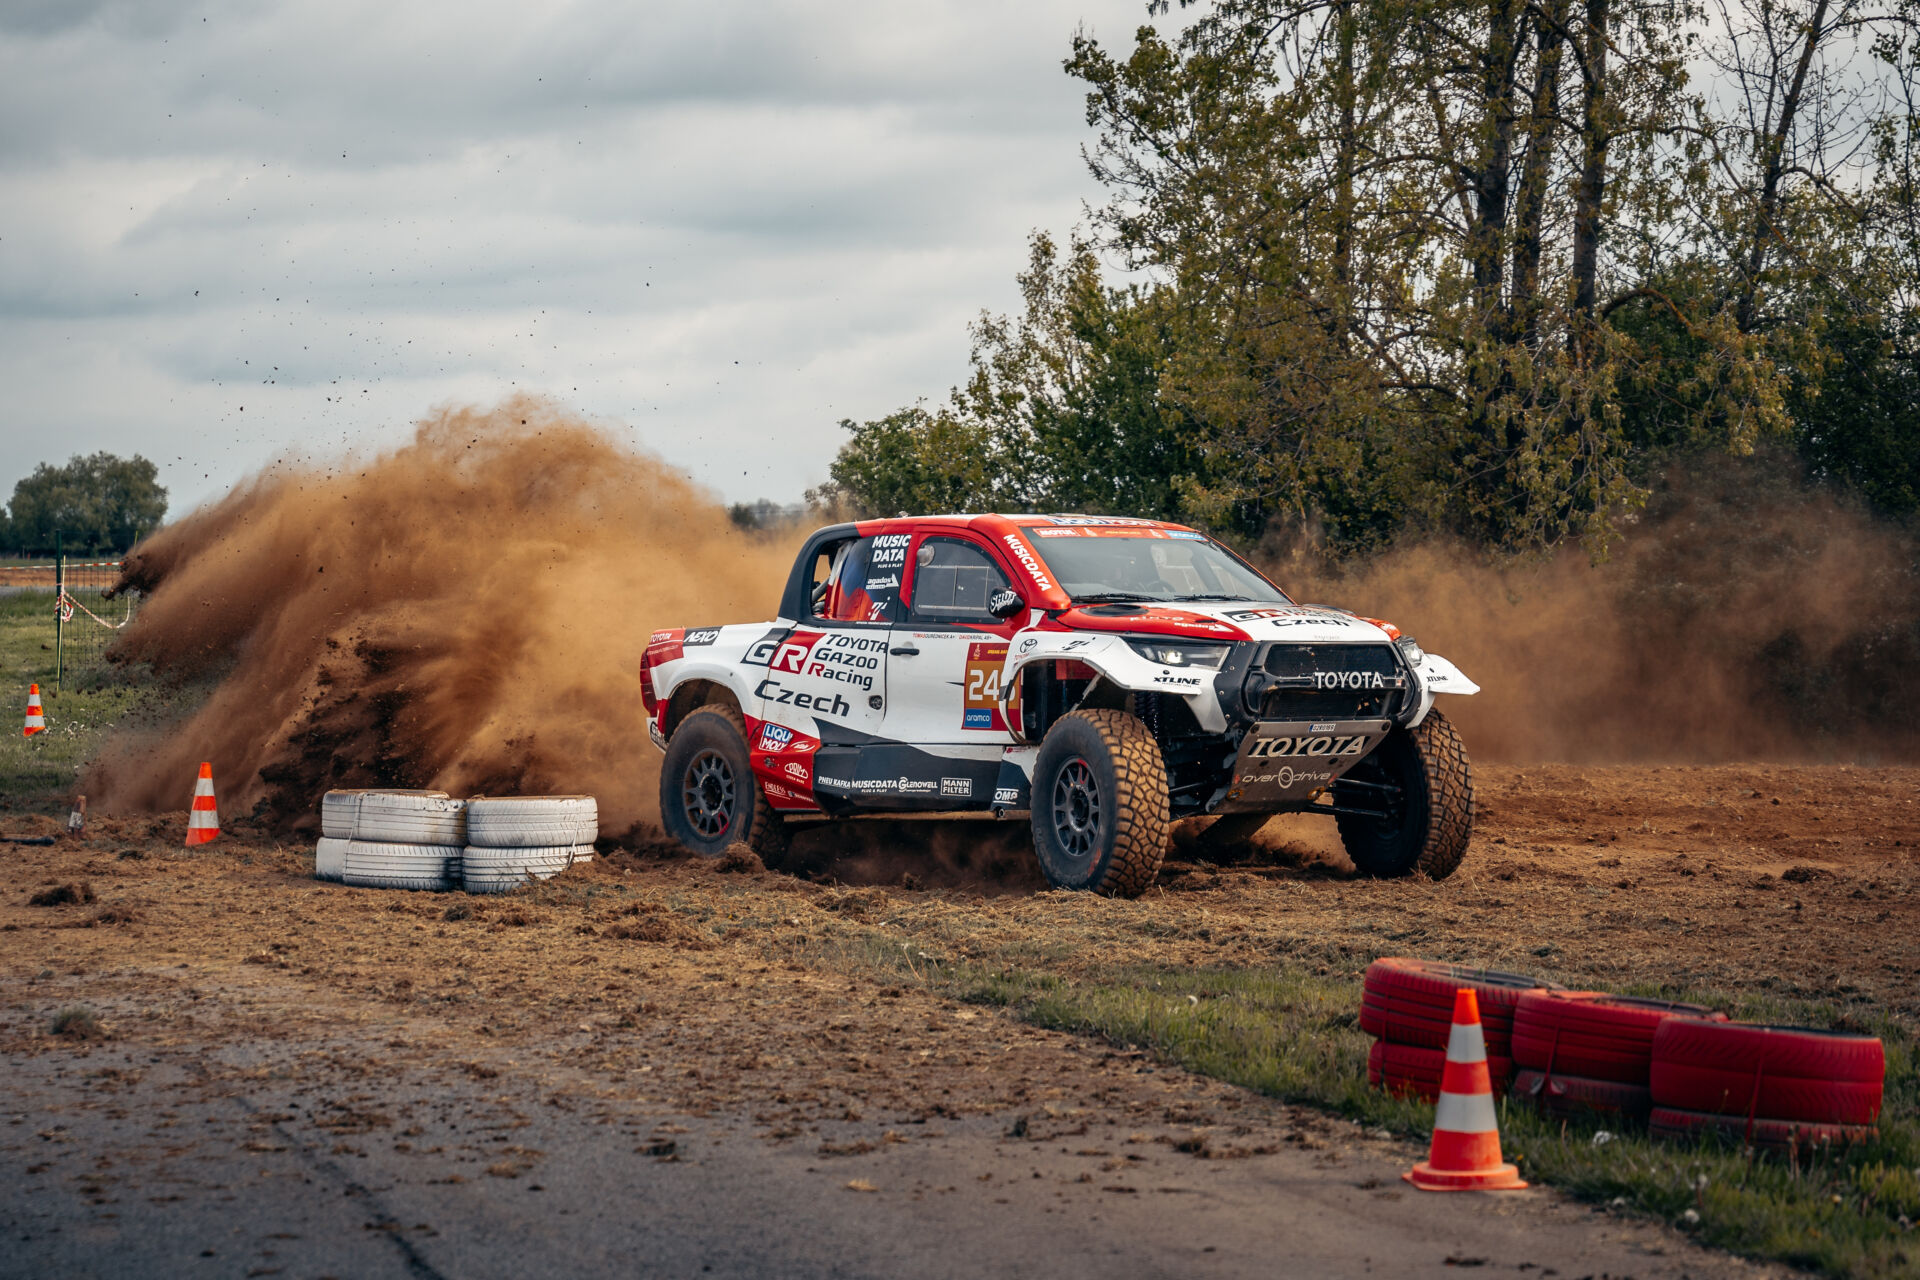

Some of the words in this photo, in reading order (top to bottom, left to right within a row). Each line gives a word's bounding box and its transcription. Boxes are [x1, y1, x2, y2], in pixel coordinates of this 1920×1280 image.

[872, 535, 911, 548] MUSIC
[873, 549, 904, 562] DATA
[1003, 534, 1052, 591] MUSICDATA
[1271, 618, 1350, 626] Czech
[826, 634, 888, 653] TOYOTA
[815, 648, 878, 669] GAZOO
[808, 662, 873, 691] Racing
[1154, 677, 1201, 685] XTLINE
[1315, 672, 1384, 688] TOYOTA
[754, 679, 851, 717] Czech
[761, 737, 787, 751] MOLY
[1251, 736, 1366, 757] TOYOTA
[818, 776, 833, 784] PNEU
[833, 778, 851, 788] KAFKA
[852, 780, 898, 789] MUSICDATA
[944, 780, 969, 788] MANN
[995, 791, 1018, 801] OMP
